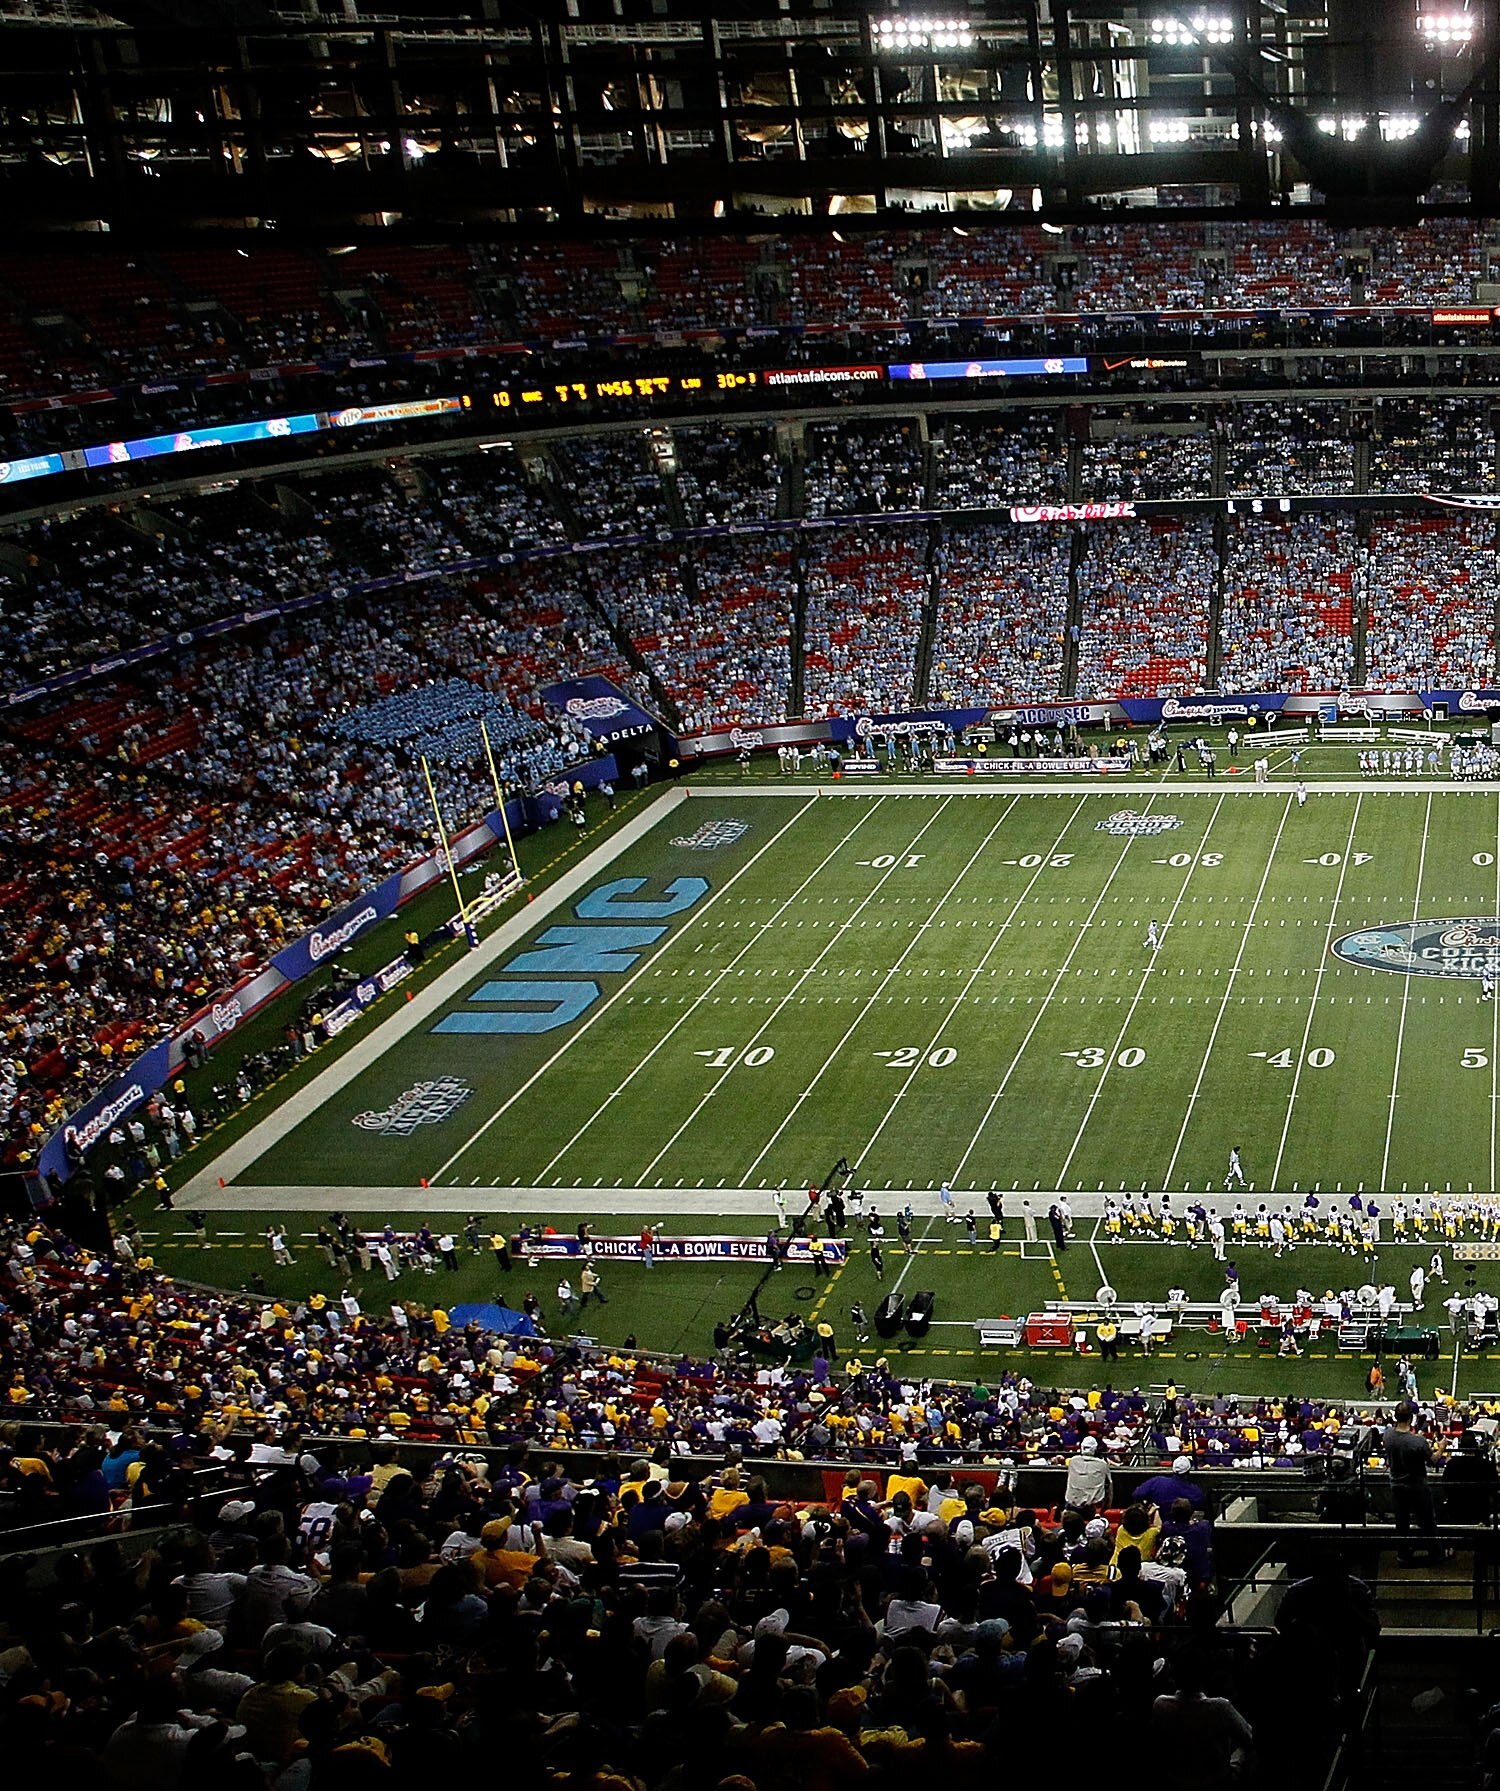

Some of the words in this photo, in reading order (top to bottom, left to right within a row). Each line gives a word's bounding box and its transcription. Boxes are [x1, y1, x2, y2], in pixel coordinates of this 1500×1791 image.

[1131, 358, 1164, 368] verizon
[768, 367, 879, 385] atlantafalcons.com
[494, 391, 510, 407] 10
[682, 378, 701, 389] LSU
[717, 373, 735, 388] 30
[1018, 709, 1047, 724] ACC
[1063, 705, 1090, 721] SEC
[1212, 705, 1246, 715] BOWL
[612, 723, 654, 741] DELTA
[983, 761, 1035, 770] CHICK-FIL-A
[1036, 761, 1063, 770] BOWL
[1063, 761, 1090, 770] EVENT
[1097, 820, 1183, 831] KICKOFF
[872, 852, 926, 869] 10
[1019, 852, 1074, 869] 20
[1170, 852, 1224, 869] 30
[1319, 852, 1374, 869] 40
[429, 876, 712, 1034] UNC
[705, 1046, 775, 1068] 10
[885, 1046, 958, 1068] 20
[1075, 1046, 1146, 1068] 30
[1266, 1047, 1336, 1069] 40
[595, 1241, 680, 1257] CHICK-IL-A
[683, 1241, 727, 1257] BOWL
[730, 1241, 767, 1257] EVEN
